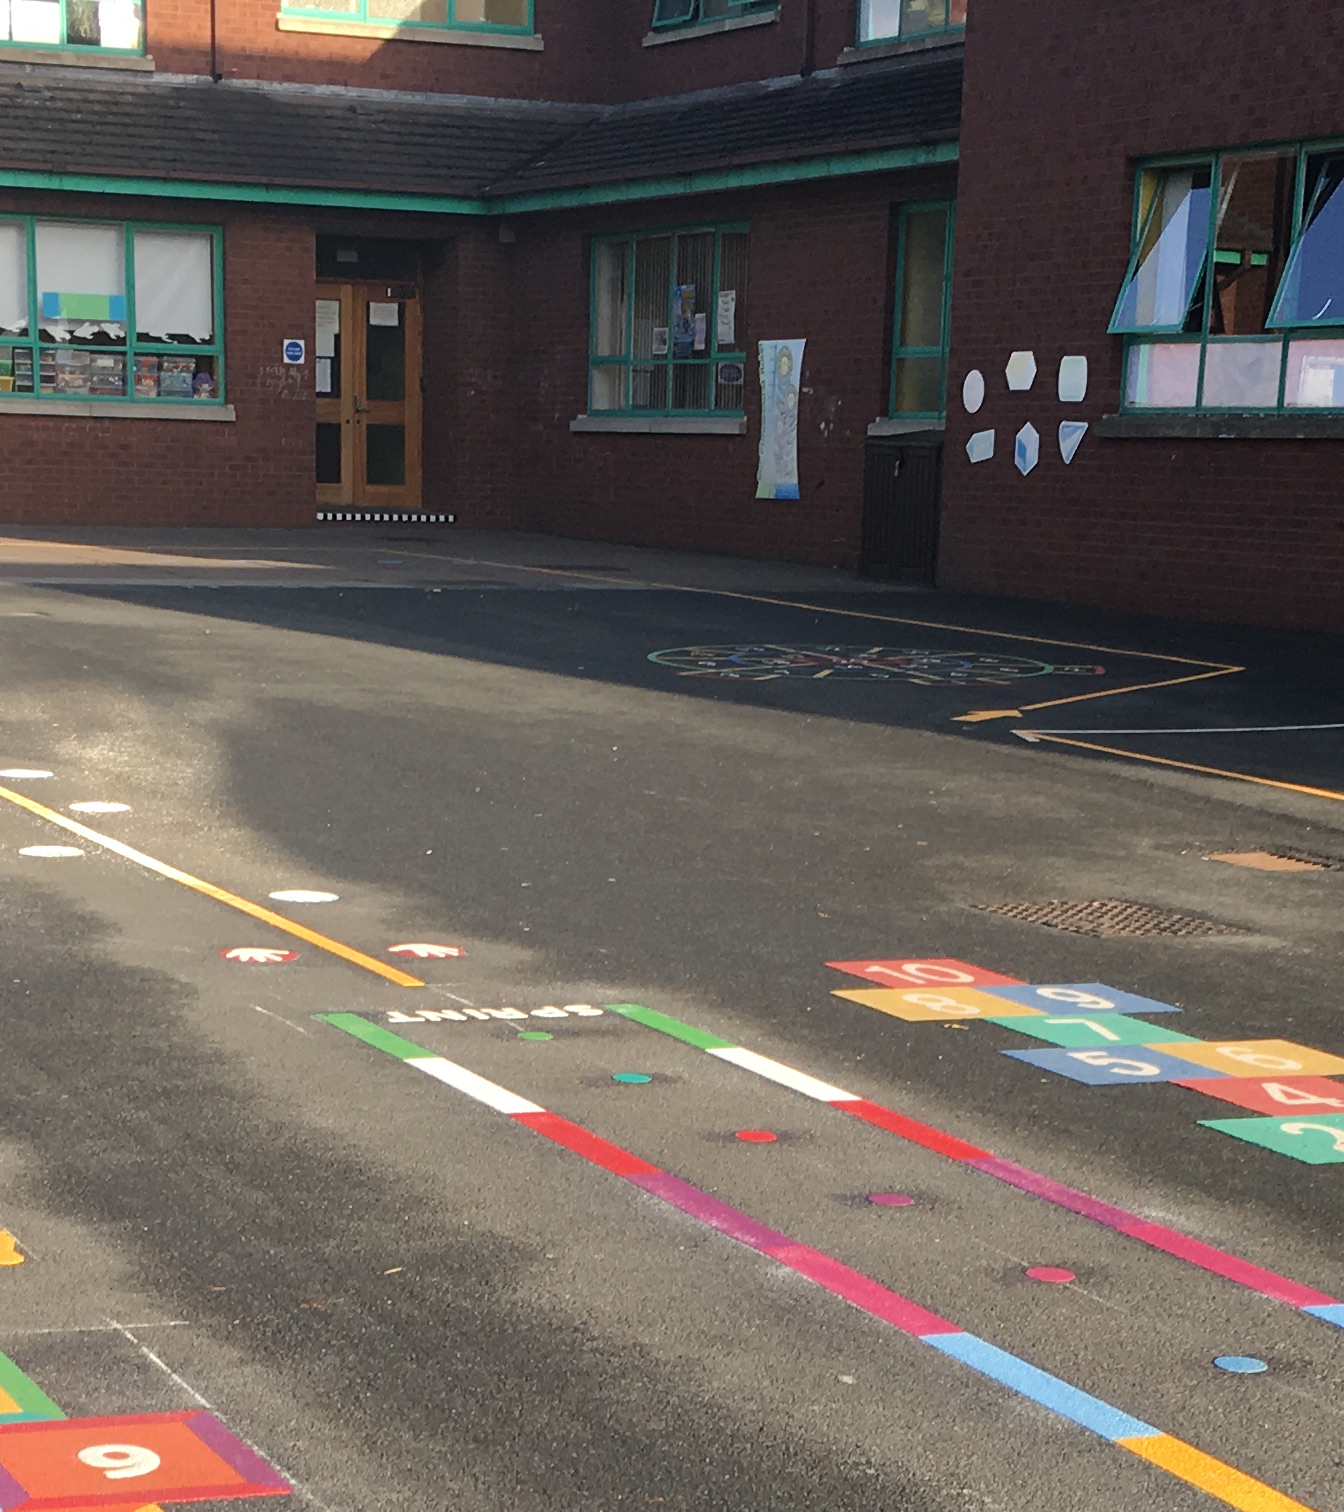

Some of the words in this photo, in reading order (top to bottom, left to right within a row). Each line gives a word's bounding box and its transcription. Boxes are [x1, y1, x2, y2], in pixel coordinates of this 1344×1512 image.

[864, 963, 975, 984] 10
[901, 993, 981, 1015] 8
[1035, 987, 1116, 1010] 9
[387, 1004, 603, 1019] SPRINT
[1044, 1019, 1120, 1041] 7
[1066, 1051, 1160, 1076] 5
[1215, 1047, 1302, 1070] 6
[77, 1443, 161, 1480] 9
